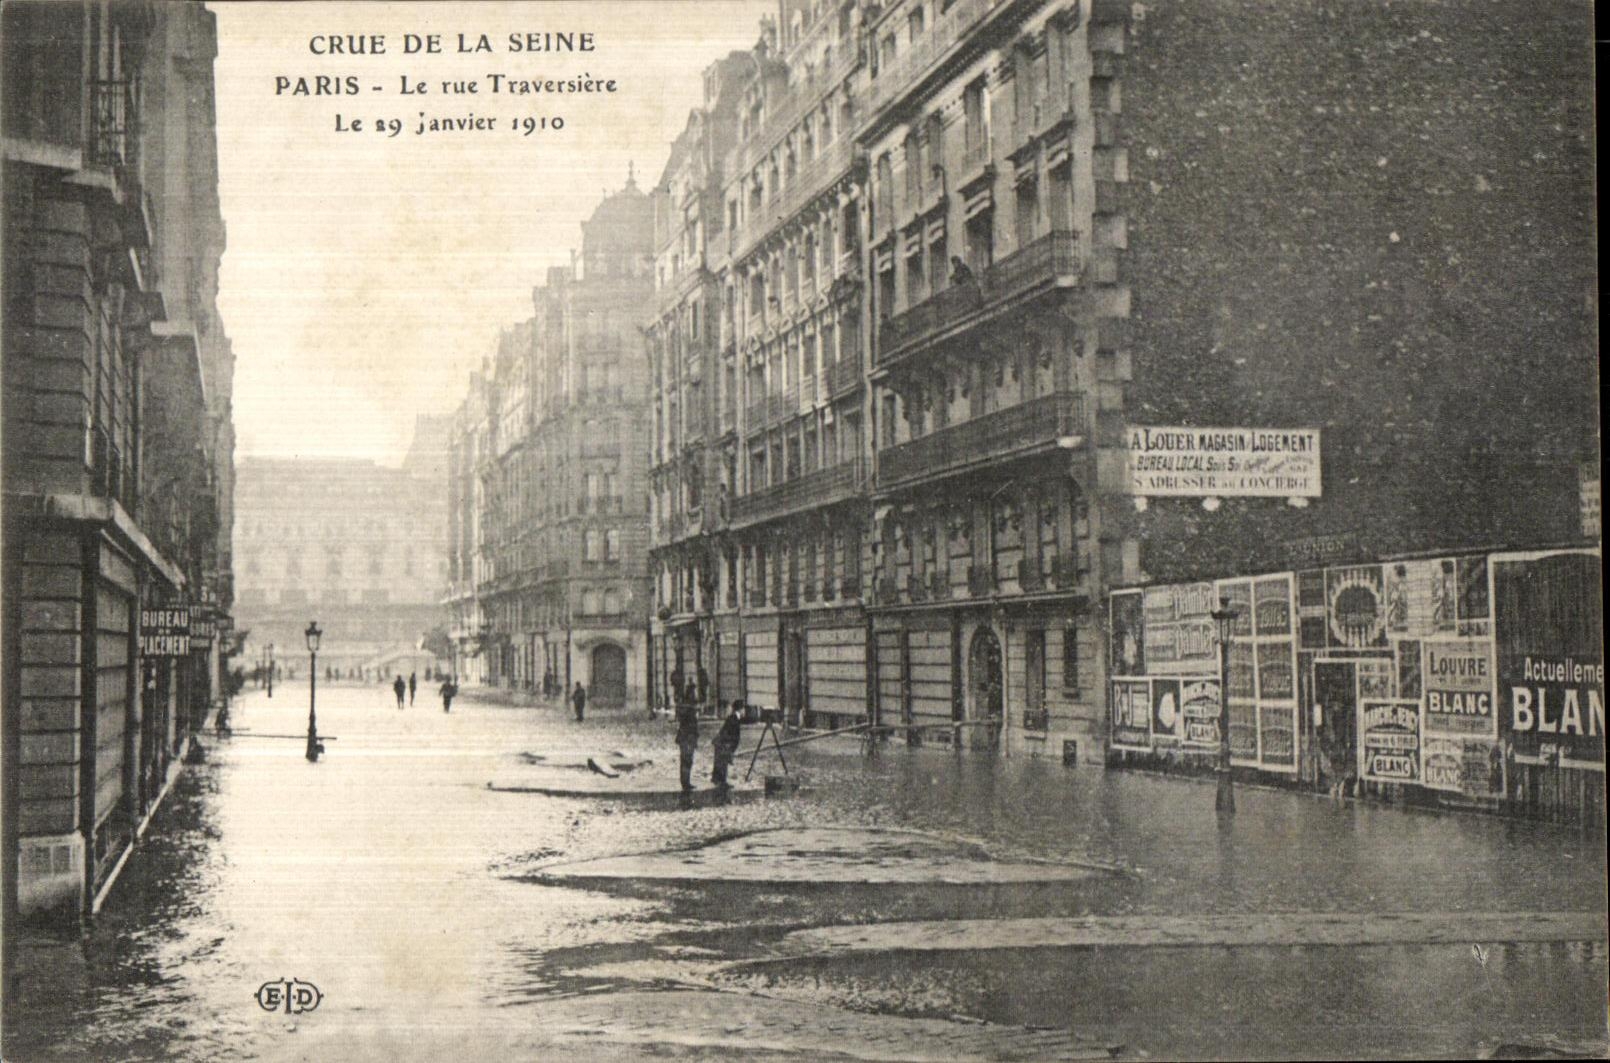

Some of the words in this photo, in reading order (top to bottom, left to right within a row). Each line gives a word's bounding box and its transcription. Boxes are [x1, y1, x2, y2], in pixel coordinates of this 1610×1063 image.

[1131, 433, 1141, 450] A
[1144, 429, 1196, 452] LOUER
[1200, 434, 1245, 451] MAGASIN
[1252, 432, 1313, 452] LOGEMENT
[1137, 456, 1174, 471] BUREAU
[1176, 455, 1203, 471] LOCAL
[1241, 476, 1309, 489] CONCIERGE
[142, 611, 188, 627] BUREAU
[139, 635, 190, 656] PLACEMENT
[1430, 651, 1487, 676] LOUVRE
[1428, 692, 1489, 715] BLANC
[1376, 758, 1410, 774] BLANC
